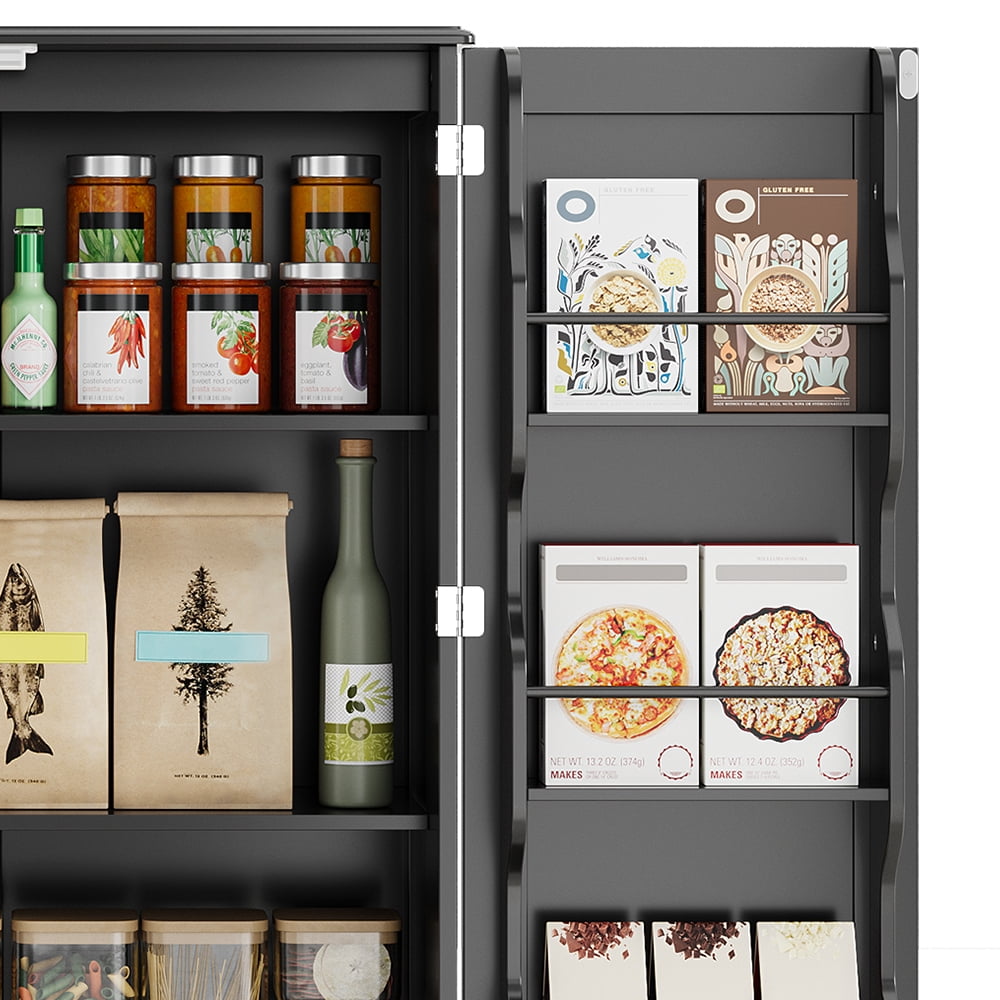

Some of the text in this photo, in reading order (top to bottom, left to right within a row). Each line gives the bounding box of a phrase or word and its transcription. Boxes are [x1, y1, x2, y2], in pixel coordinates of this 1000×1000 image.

[550, 757, 567, 766] NET
[710, 757, 727, 766] NET
[550, 770, 583, 779] MAKES
[710, 770, 743, 779] MAKES
